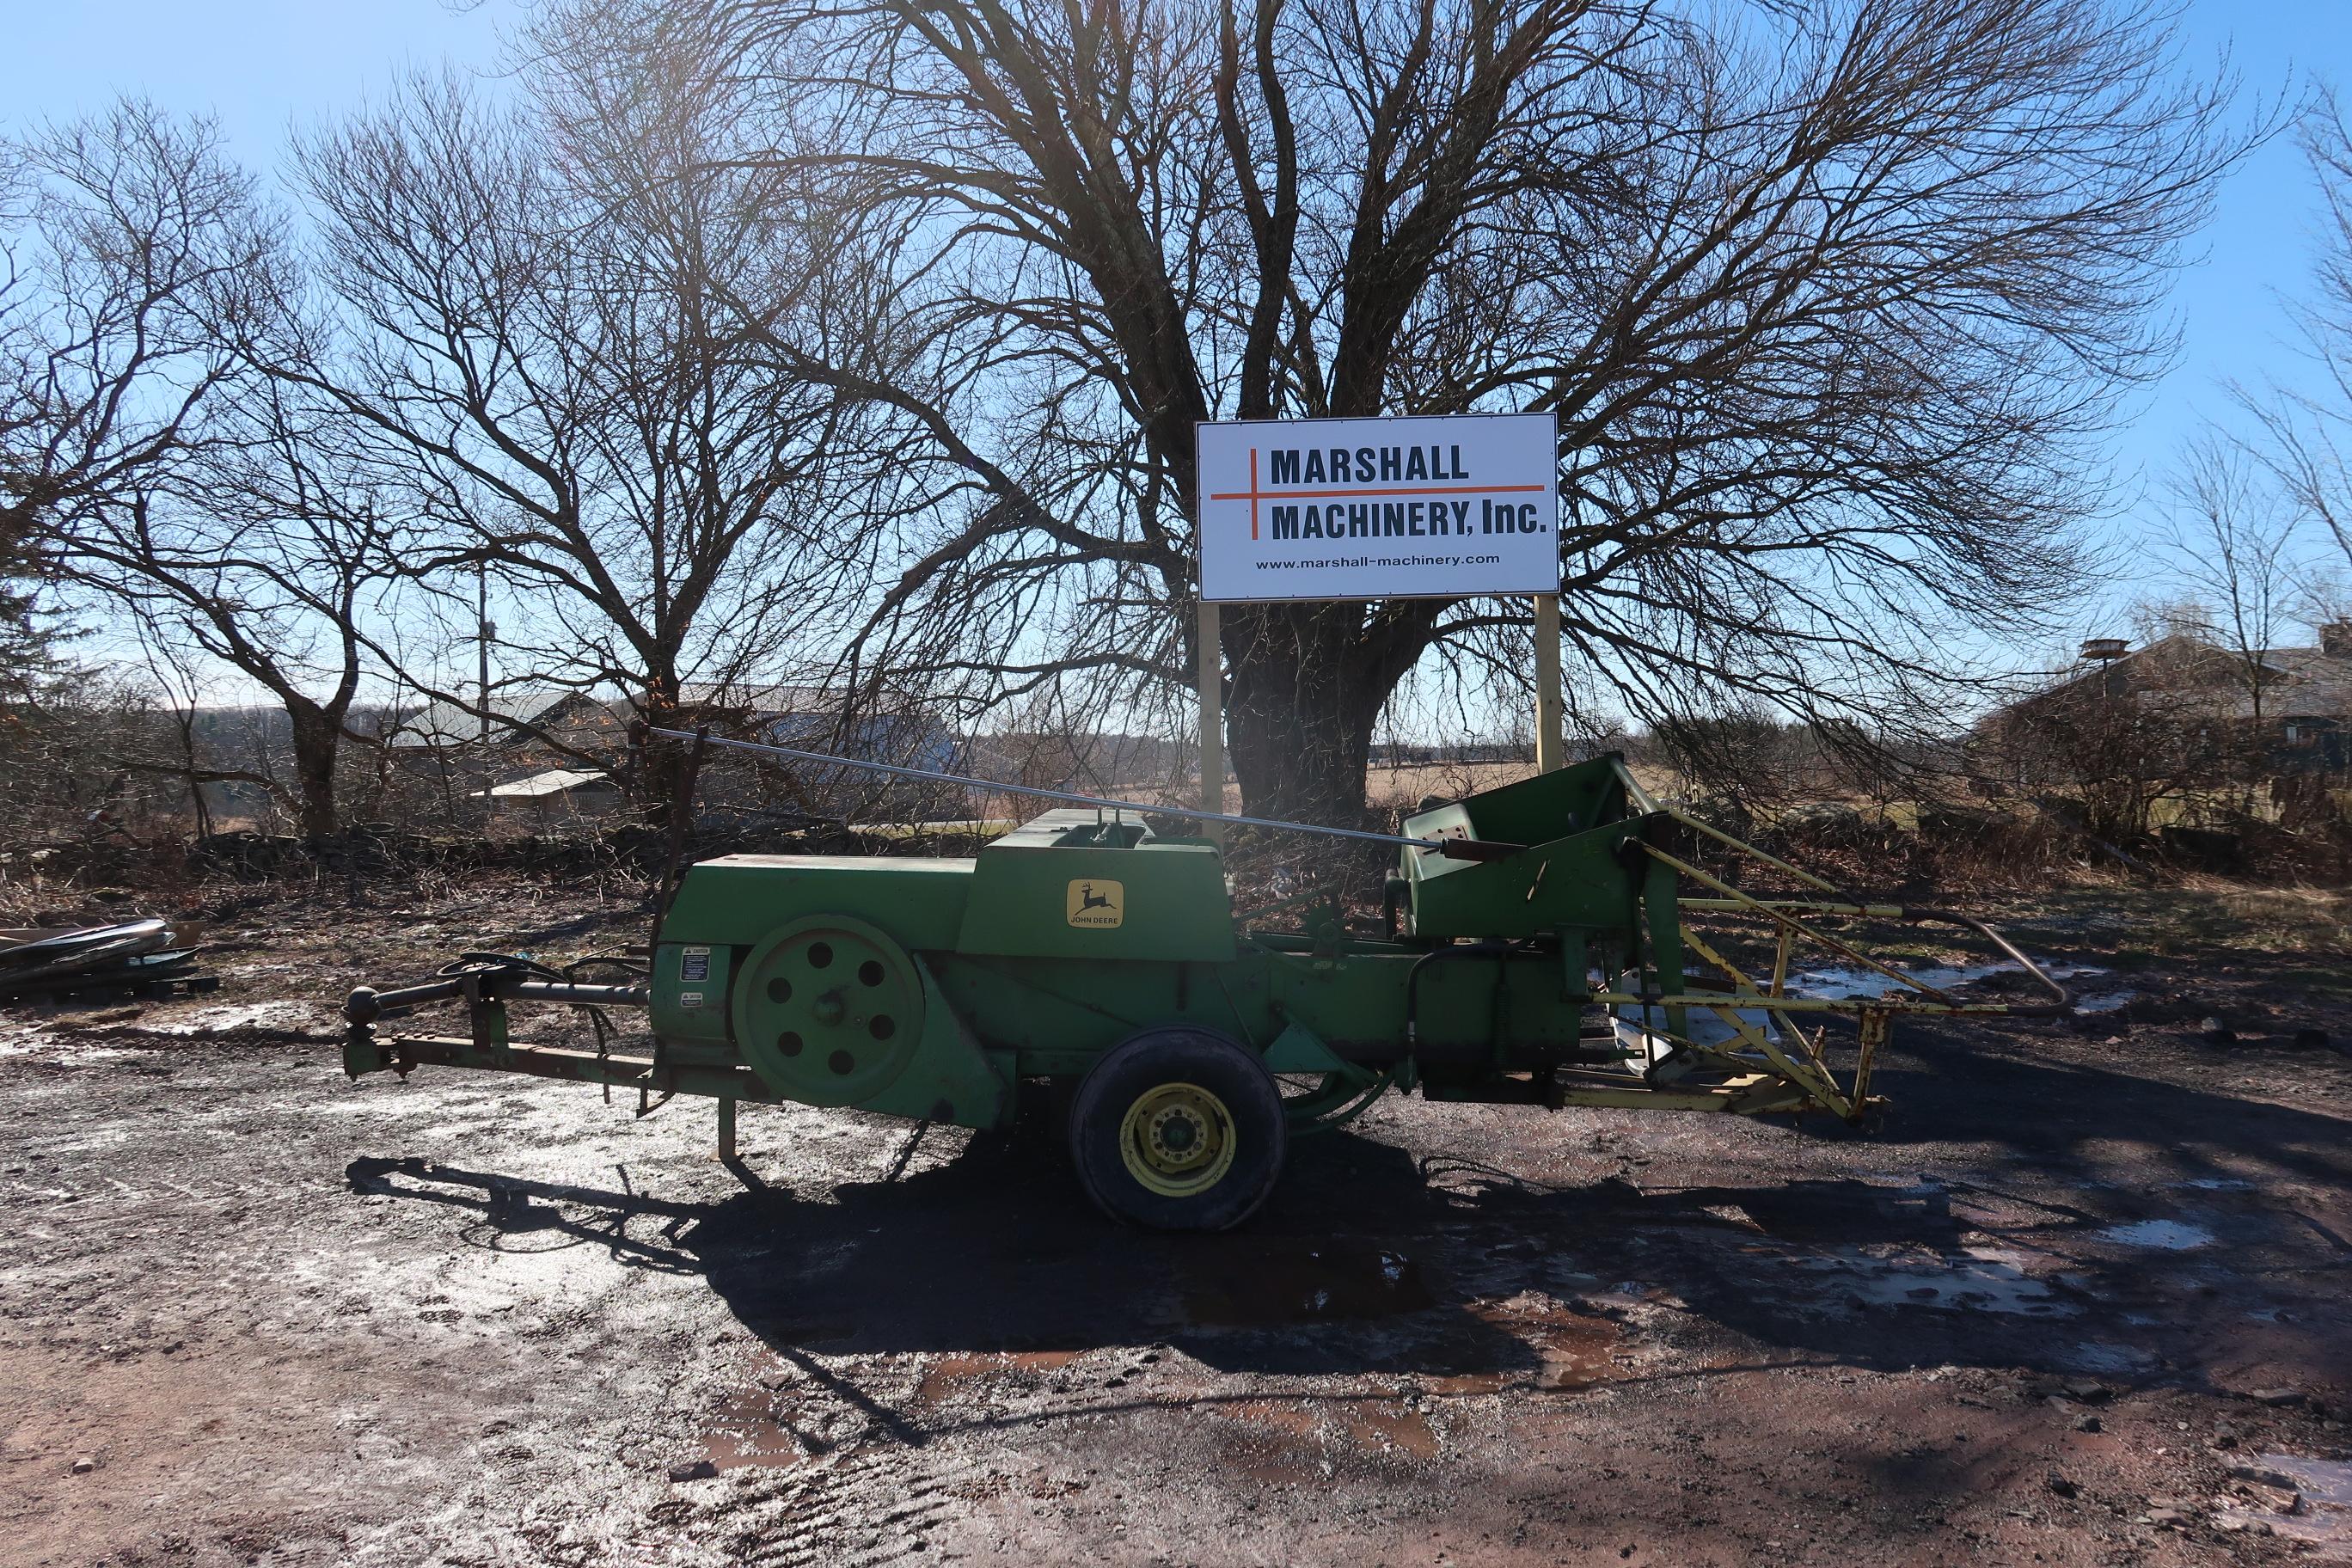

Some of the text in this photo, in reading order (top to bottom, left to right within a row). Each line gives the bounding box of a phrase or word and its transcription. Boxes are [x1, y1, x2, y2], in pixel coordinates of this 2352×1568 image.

[1271, 444, 1469, 484] MARSHALL
[1271, 499, 1547, 540] MACHINERY, Inc.
[1256, 554, 1500, 569] www.marshall-machinery.com
